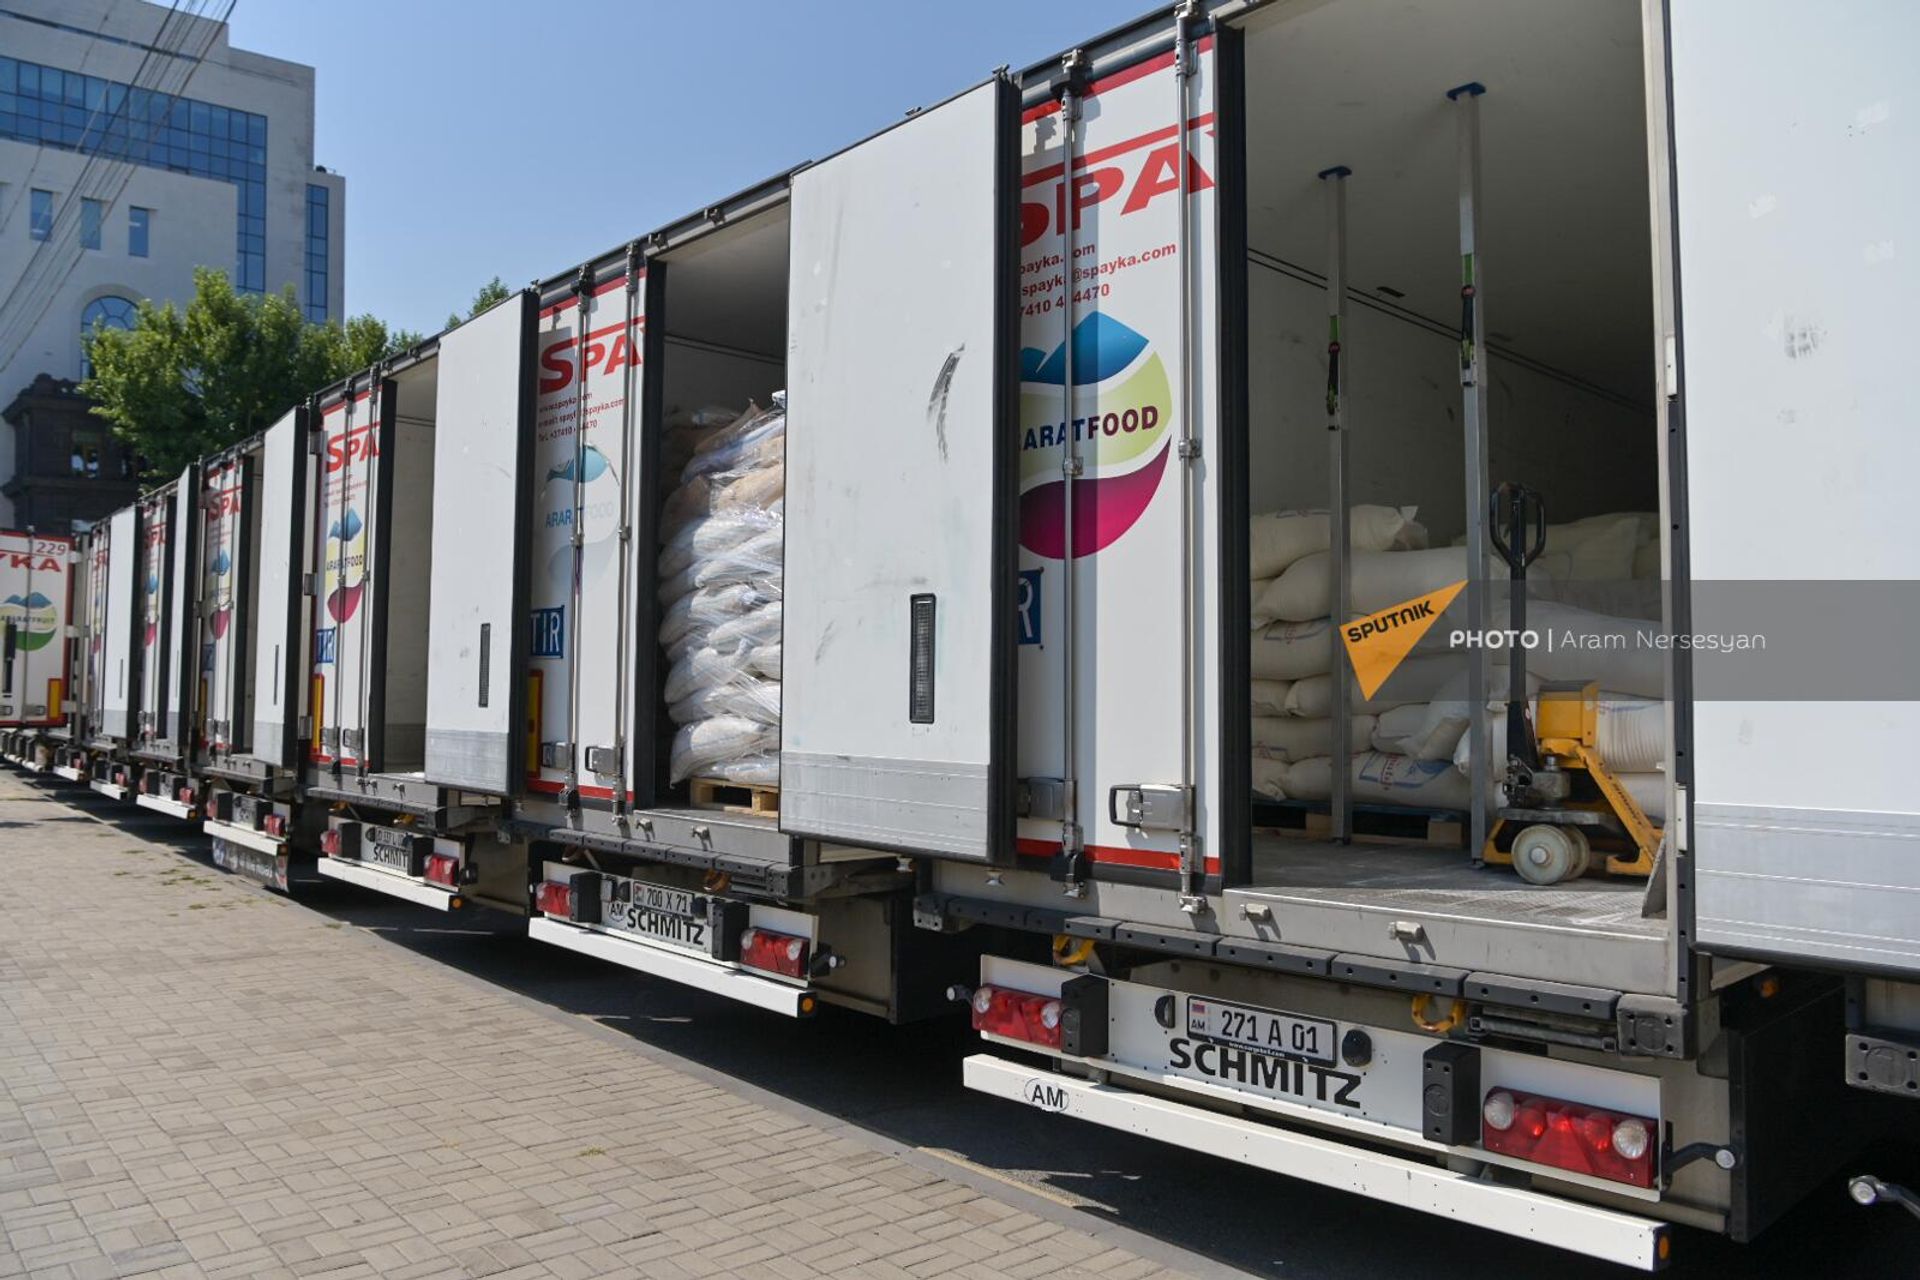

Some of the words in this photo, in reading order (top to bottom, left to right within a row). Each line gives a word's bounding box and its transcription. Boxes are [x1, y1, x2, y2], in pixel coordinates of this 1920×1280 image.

[36, 541, 67, 556] 229
[0, 553, 62, 573] KA
[627, 908, 705, 946] SCHMITZ
[1190, 1018, 1206, 1032] AM
[1221, 1009, 1259, 1043] 271
[1267, 1018, 1283, 1047] A
[1292, 1022, 1319, 1054] 01
[1169, 1037, 1362, 1109] SCHMITZ
[1031, 1084, 1064, 1108] AM
